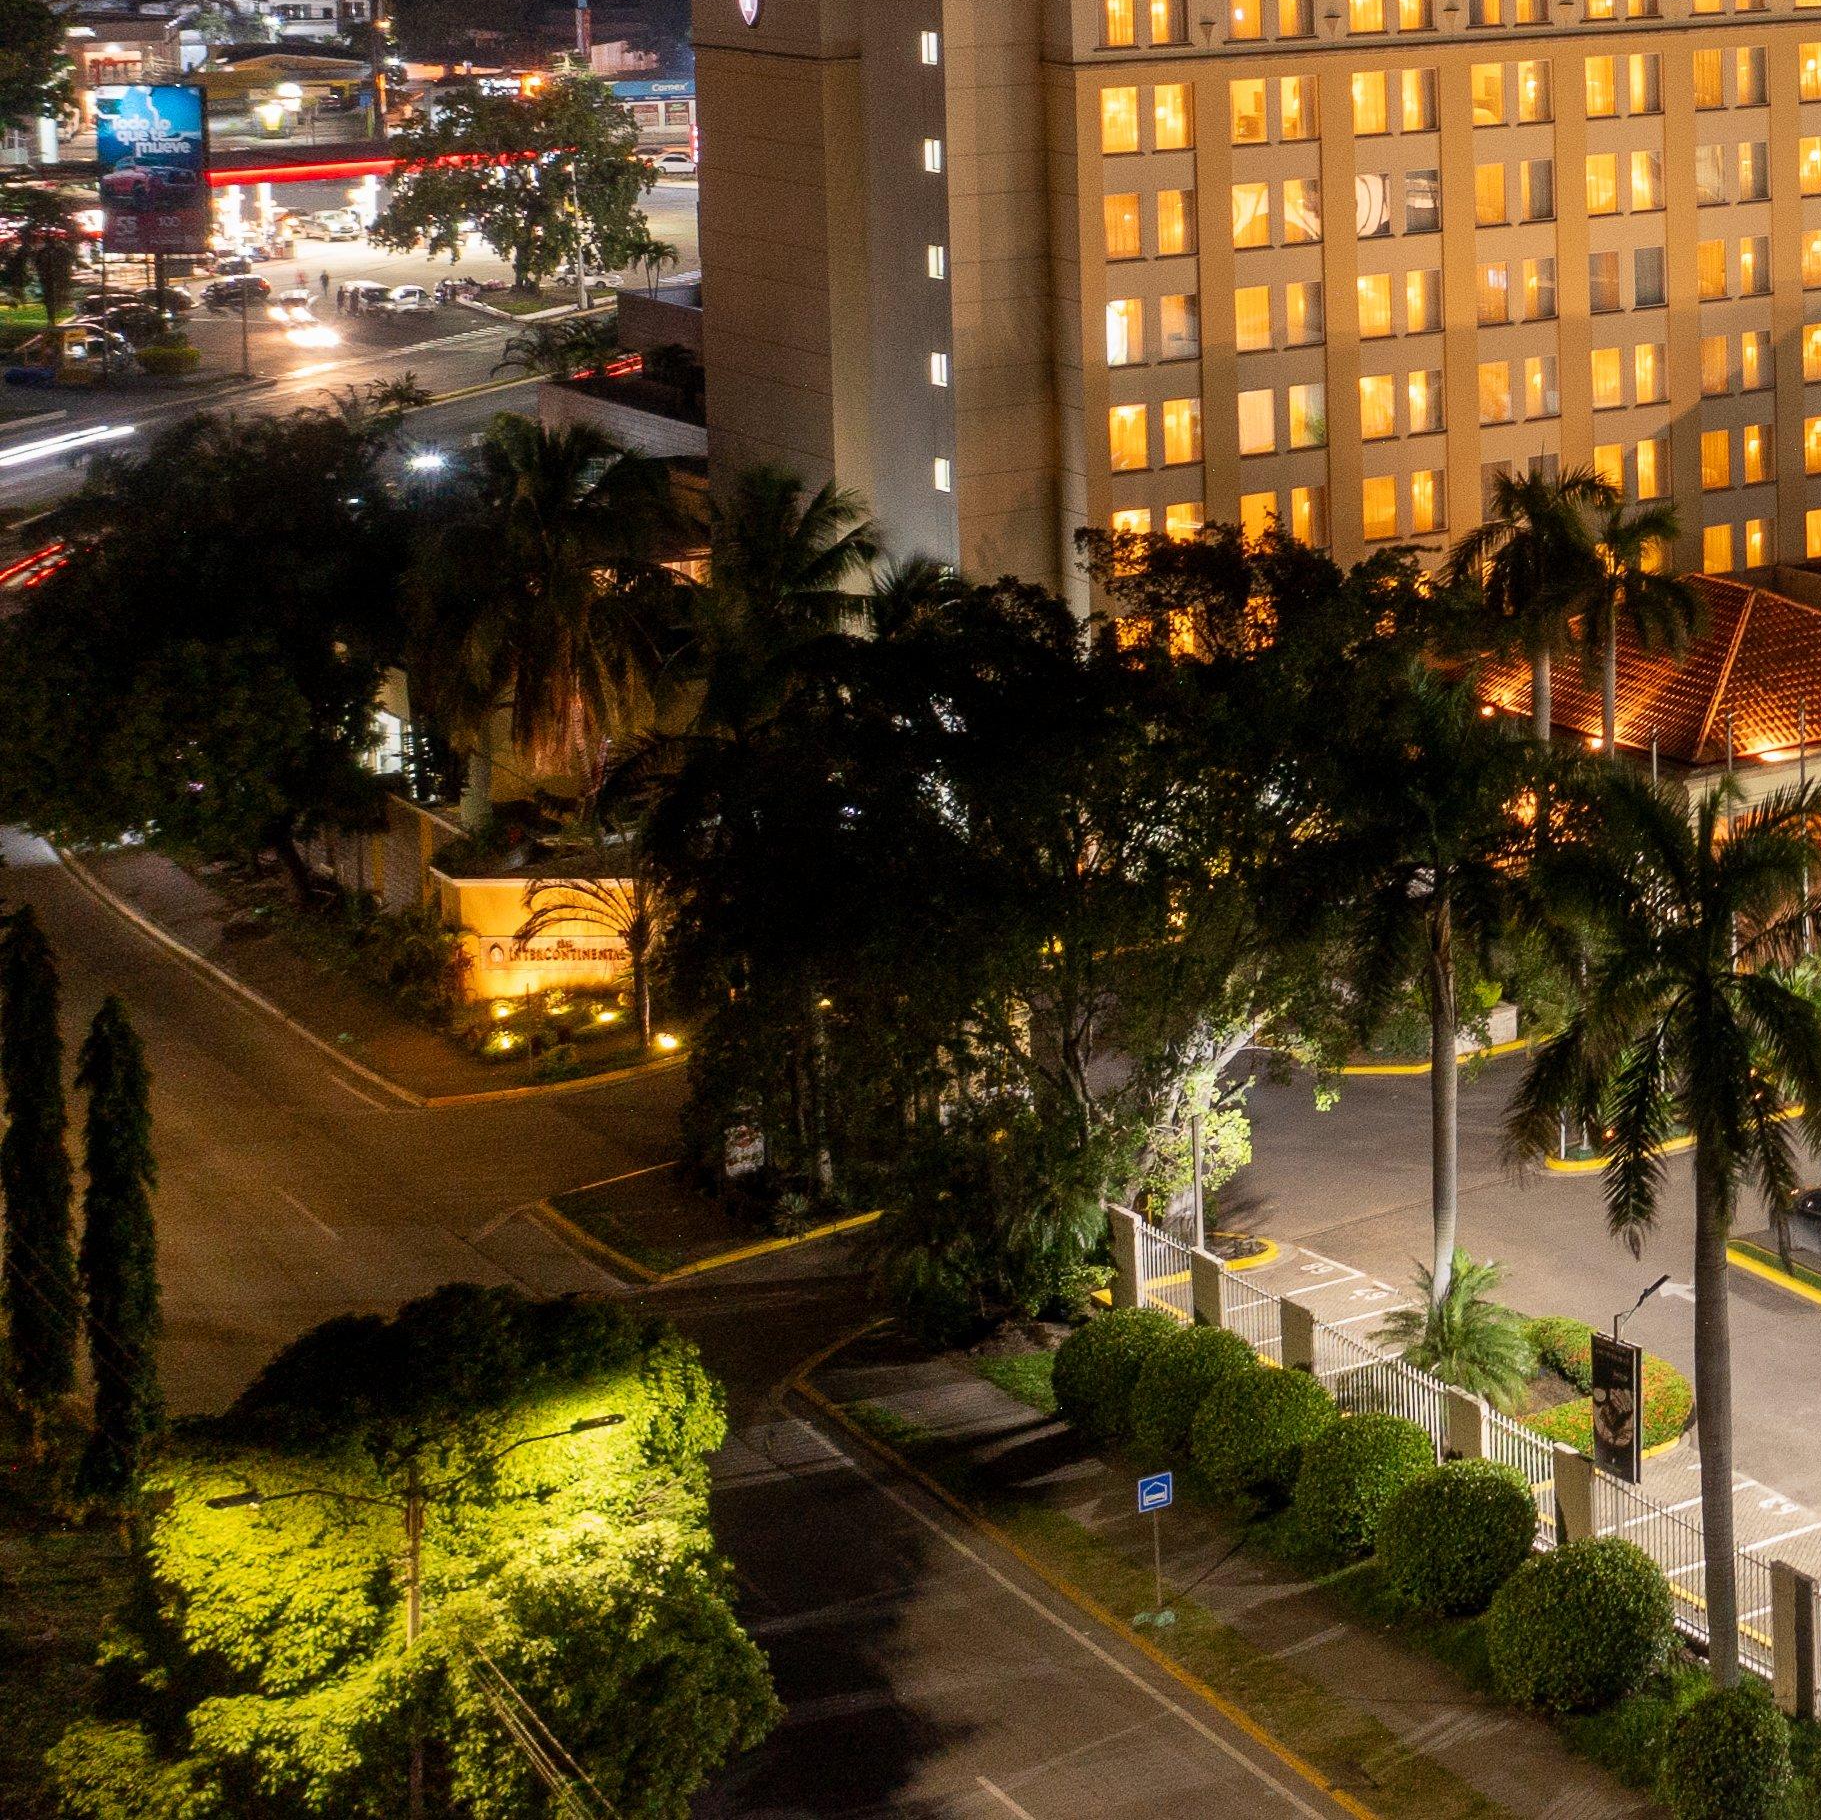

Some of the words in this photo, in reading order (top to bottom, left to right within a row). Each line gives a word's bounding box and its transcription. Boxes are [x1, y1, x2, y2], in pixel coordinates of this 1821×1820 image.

[651, 82, 686, 92] Comex
[112, 114, 149, 130] Todo
[116, 130, 151, 146] que
[135, 141, 191, 157] mueve
